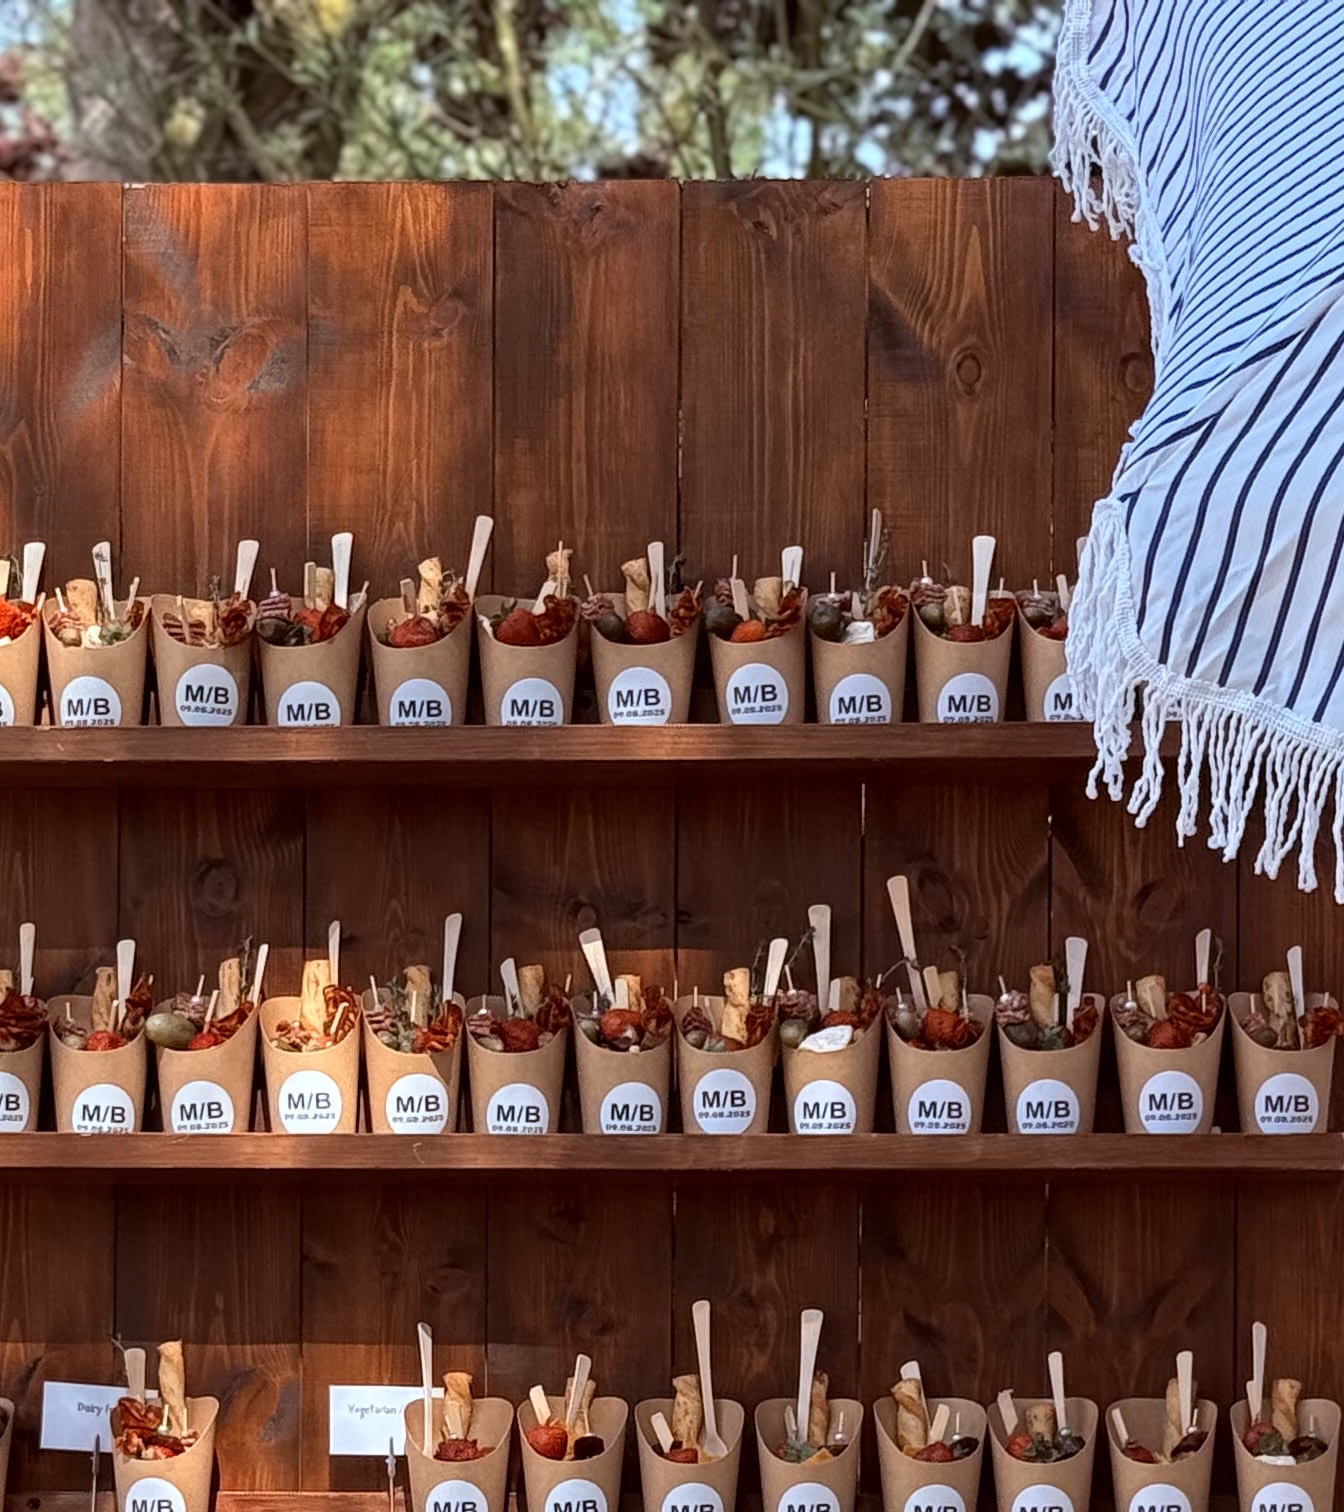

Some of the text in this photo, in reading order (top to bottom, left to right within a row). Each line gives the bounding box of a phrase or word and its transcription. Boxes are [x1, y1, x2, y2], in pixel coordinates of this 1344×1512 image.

[184, 684, 230, 705] M/B
[616, 688, 661, 708] M/B
[733, 683, 778, 705] M/B
[947, 694, 992, 714] M/B
[1053, 692, 1073, 712] M
[67, 697, 111, 717] M/B
[286, 702, 332, 722] M/B
[398, 699, 443, 719] M/B
[510, 698, 555, 718] M/B
[838, 694, 883, 715] M/B
[287, 1092, 331, 1111] M/B
[396, 1094, 441, 1114] M/B
[701, 1089, 747, 1109] M/B
[1148, 1092, 1195, 1112] M/B
[1264, 1094, 1310, 1113] M/B
[81, 1104, 126, 1124] M/B
[179, 1101, 224, 1122] M/B
[496, 1104, 541, 1124] M/B
[610, 1103, 655, 1122] M/B
[802, 1101, 847, 1120] M/B
[918, 1100, 963, 1120] M/B
[1025, 1100, 1071, 1120] M/B
